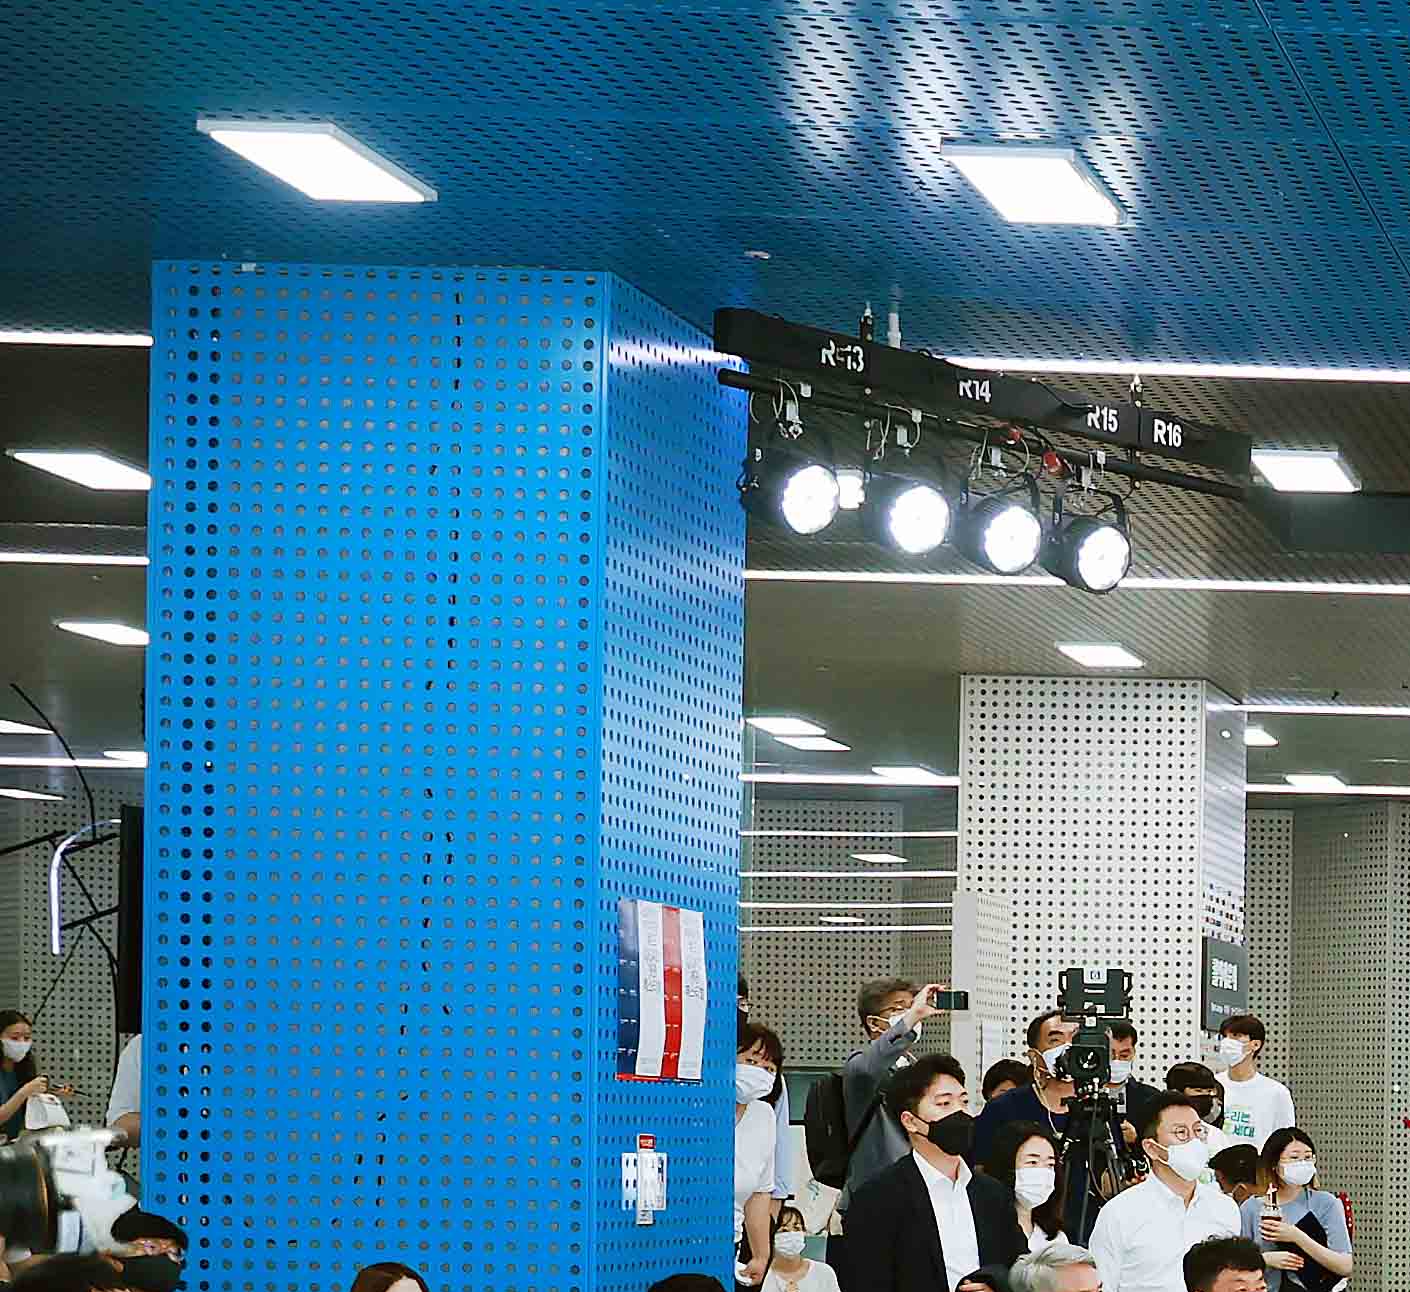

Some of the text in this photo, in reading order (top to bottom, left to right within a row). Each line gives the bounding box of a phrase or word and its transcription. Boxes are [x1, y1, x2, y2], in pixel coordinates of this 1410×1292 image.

[958, 379, 991, 403] R14
[1087, 405, 1119, 433] R15
[1153, 419, 1183, 448] R16
